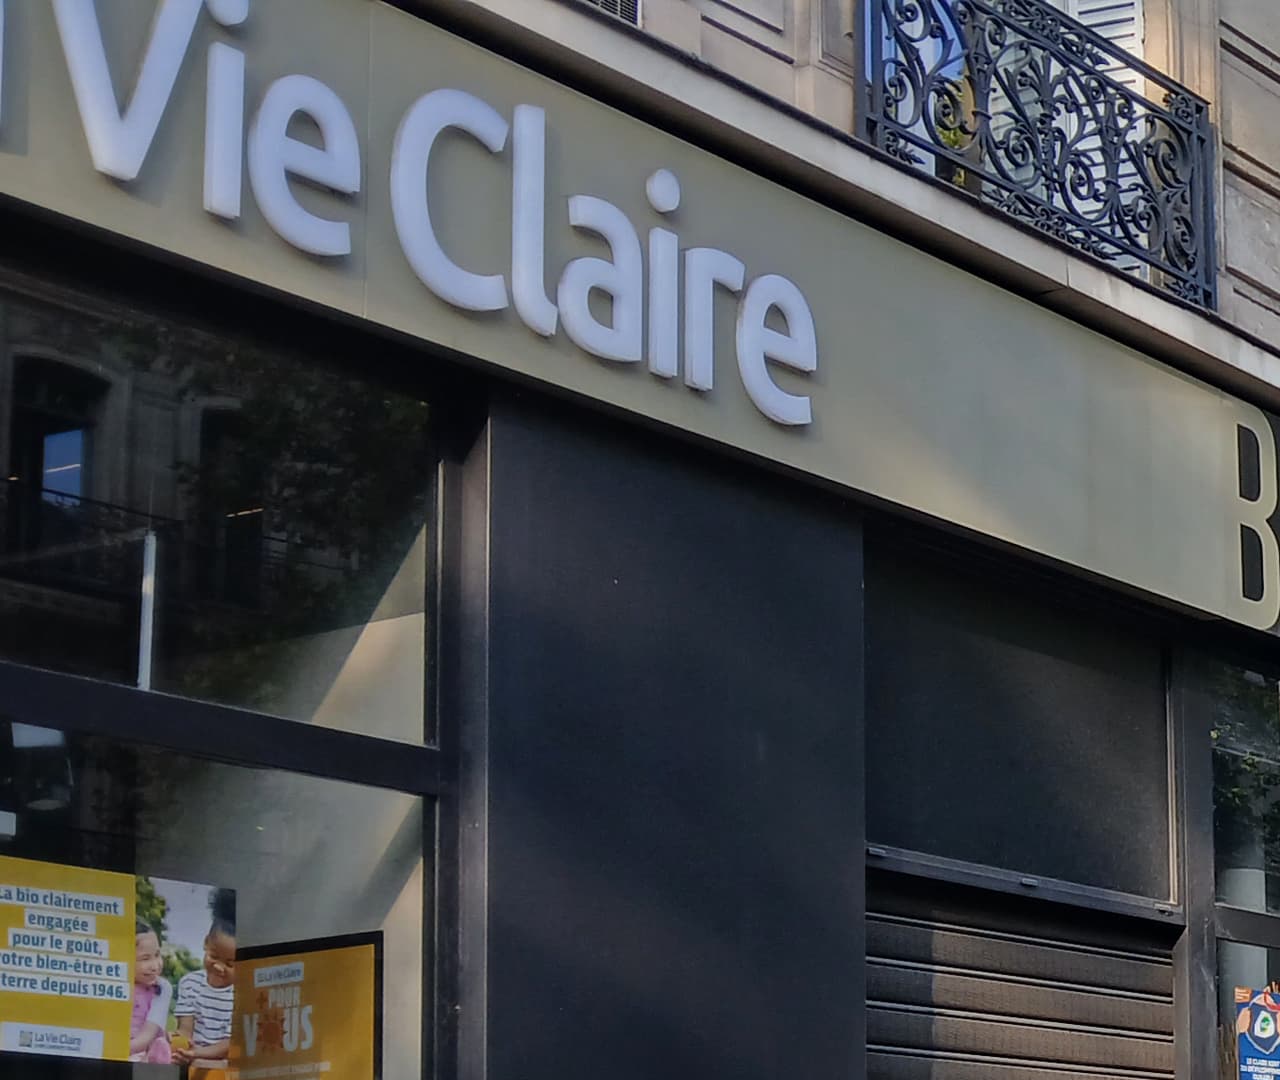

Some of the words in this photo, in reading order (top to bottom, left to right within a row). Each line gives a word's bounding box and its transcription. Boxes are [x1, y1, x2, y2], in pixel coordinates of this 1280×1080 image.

[53, 0, 361, 256] Vie
[389, 87, 818, 427] Claire
[16, 887, 39, 905] bio
[42, 892, 119, 915] clairement
[28, 913, 89, 933] engagée
[12, 933, 47, 949] pour
[50, 934, 63, 950] le
[66, 938, 103, 956] goût,
[0, 951, 33, 968] otre
[36, 954, 103, 976] bien-être
[106, 963, 120, 978] et
[1, 973, 38, 991] terre
[41, 976, 89, 996] depuis
[92, 983, 127, 1000] 1946.
